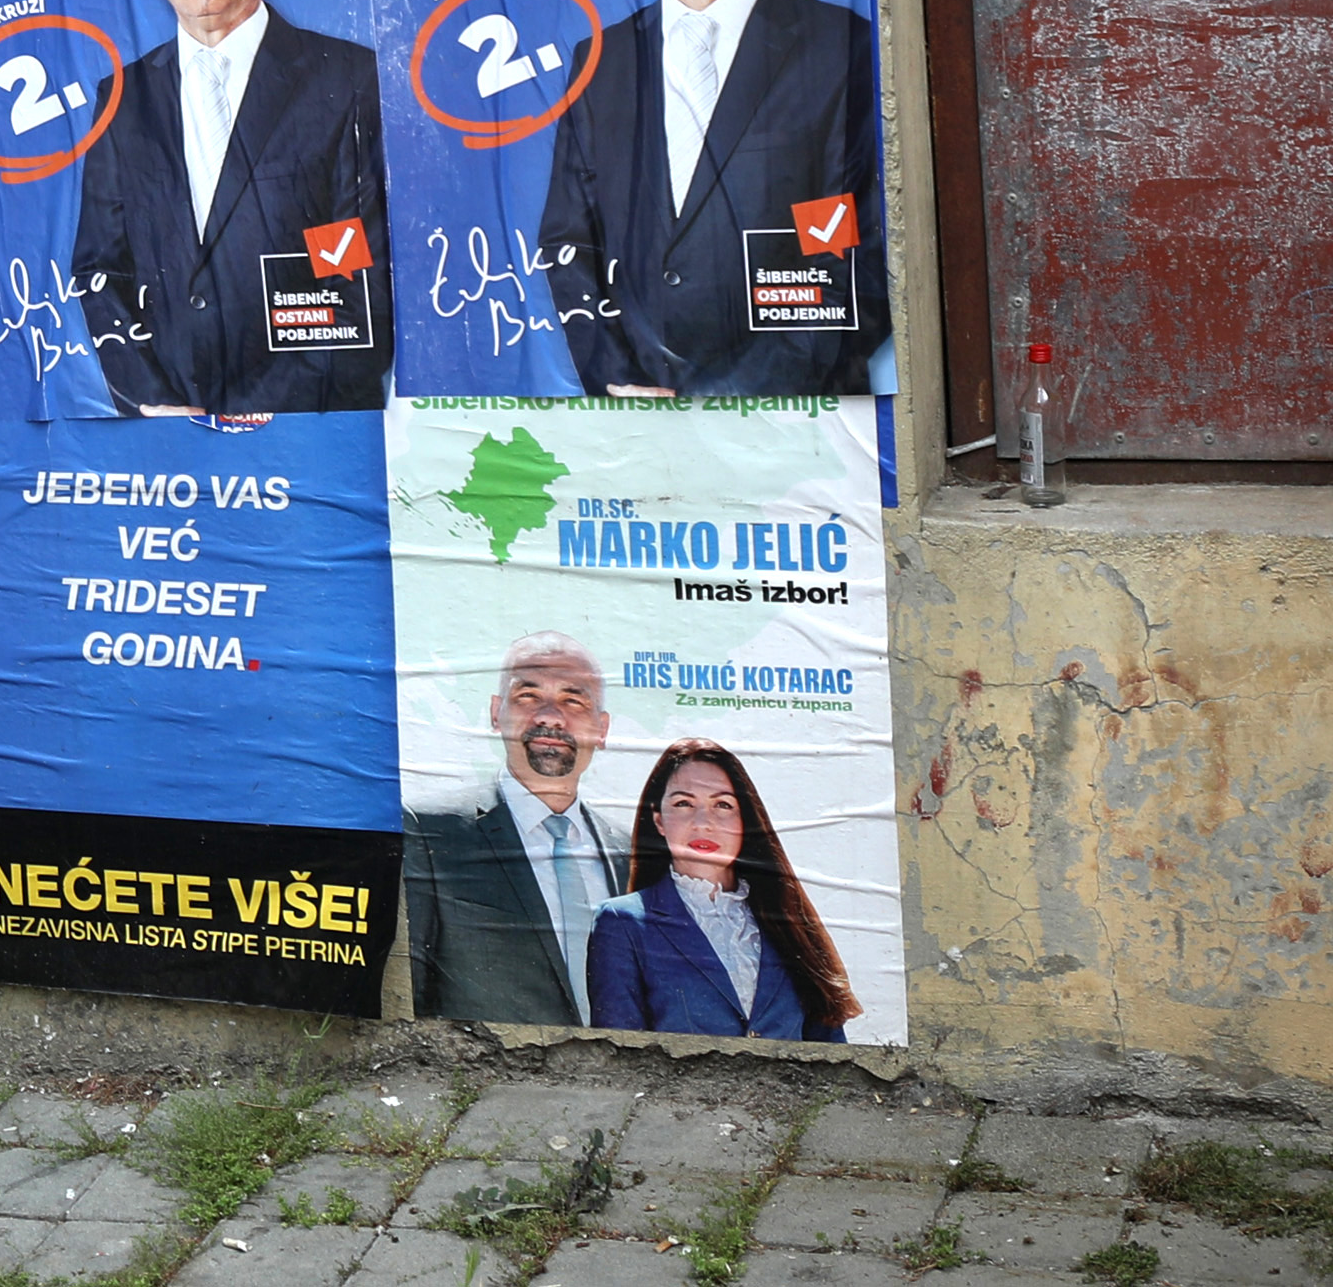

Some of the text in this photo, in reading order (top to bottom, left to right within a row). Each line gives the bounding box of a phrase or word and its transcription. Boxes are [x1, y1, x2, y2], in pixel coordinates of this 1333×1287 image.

[458, 14, 563, 99] 2.
[756, 268, 832, 285] ŠIBENIČE,
[758, 288, 815, 303] OSTANI
[758, 305, 846, 322] POBJEDNIK
[24, 471, 290, 511] JEBEMO VAS
[578, 498, 640, 519] DR.SC.
[118, 520, 201, 561] VEĆ
[559, 514, 848, 573] MARKO JELIĆ
[62, 578, 266, 617] TRIDESET
[675, 578, 849, 605] Imaš izbor!
[82, 632, 260, 671] GODINA.
[624, 660, 853, 695] IRIS UKIĆ KOTARAC
[676, 693, 853, 713] Za zamjenicu župana
[229, 871, 370, 934] VIŠE!
[125, 924, 186, 947] LISTA
[193, 930, 259, 955] STIPE
[265, 936, 365, 966] PETRINA
